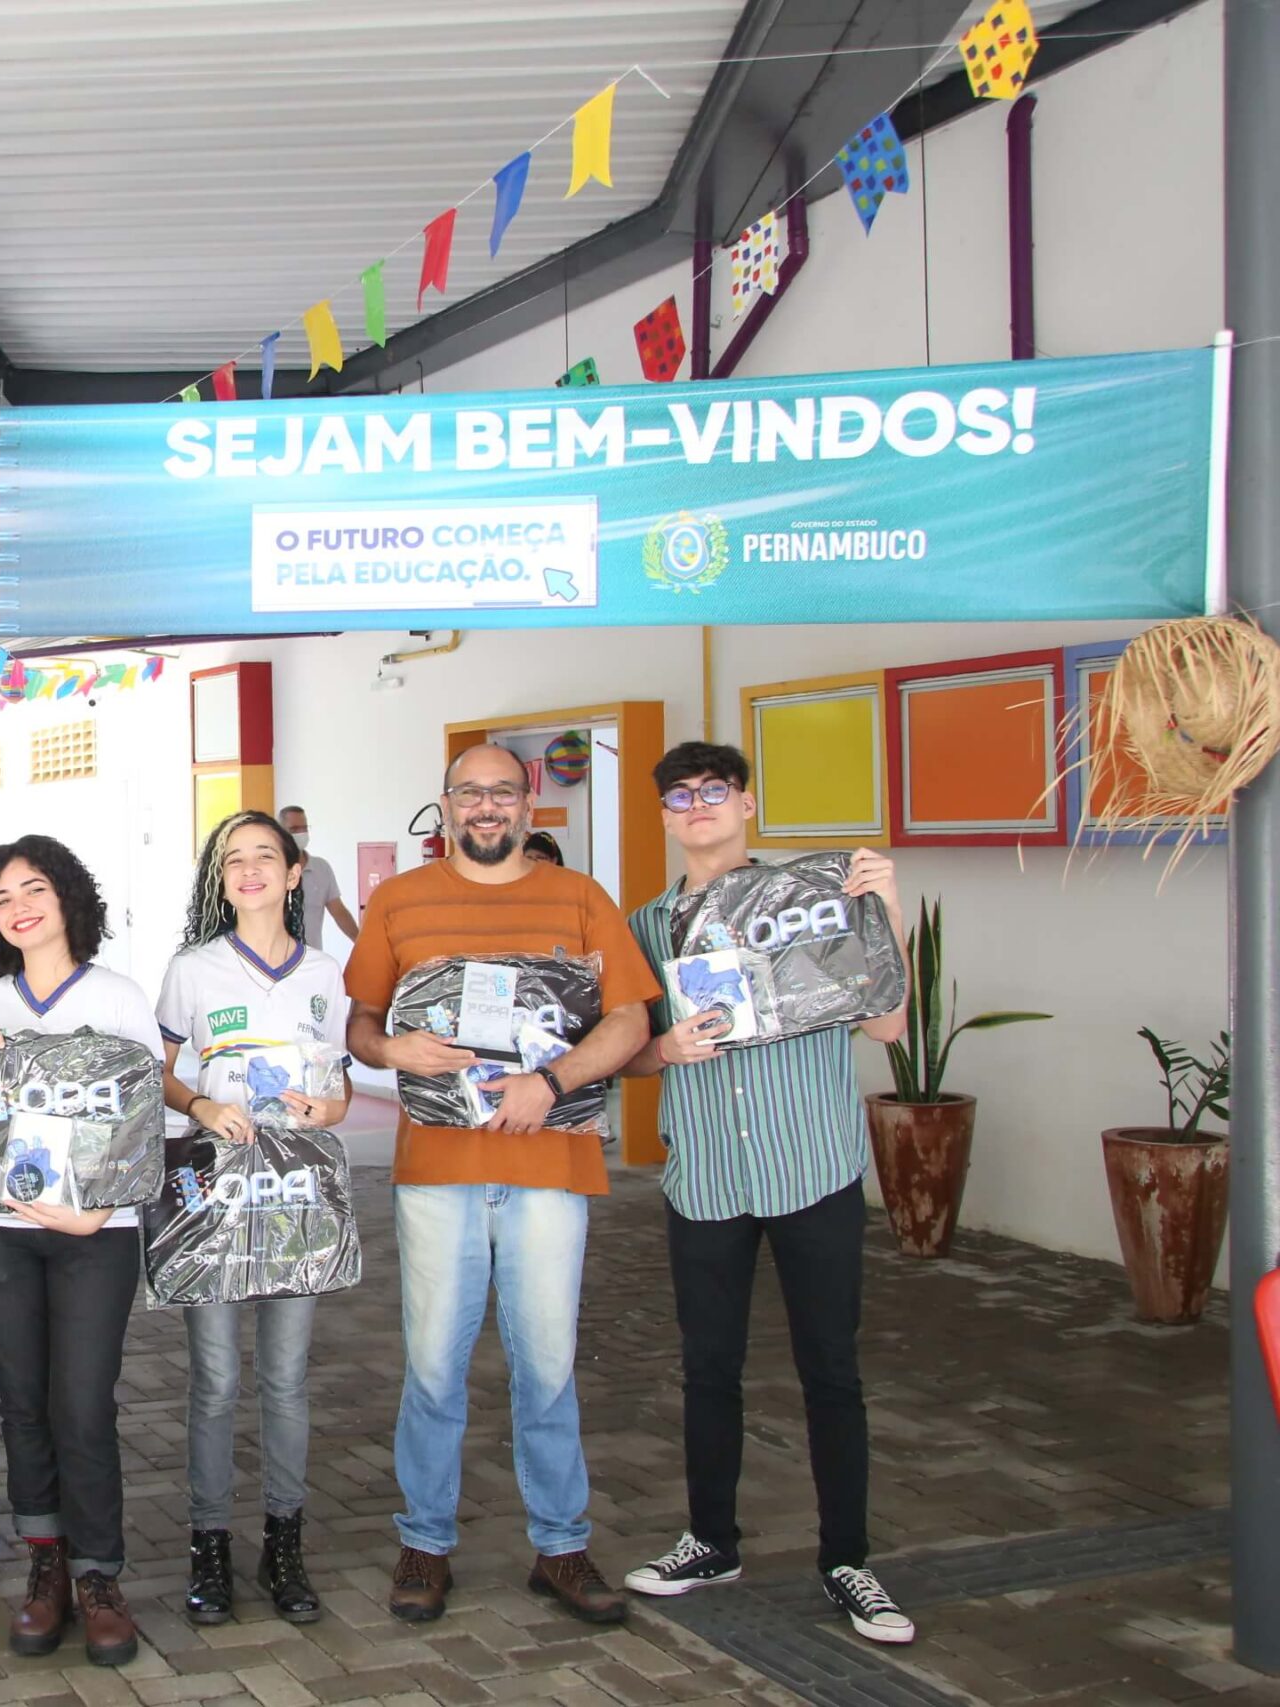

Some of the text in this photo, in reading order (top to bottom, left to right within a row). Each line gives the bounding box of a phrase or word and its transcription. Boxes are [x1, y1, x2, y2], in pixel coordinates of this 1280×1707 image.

[163, 387, 1037, 479] SEJAM BEM-VINDOS!
[276, 522, 567, 553] O FUTURO COMEÇA
[790, 519, 878, 529] GOVERNO DO ESTADO
[742, 530, 927, 563] PERNAMBUCO
[276, 553, 531, 589] PELA EDUCAÇÃO.
[747, 899, 849, 948] OPA
[208, 1008, 246, 1030] NAVE
[20, 1080, 121, 1115] OPA
[215, 1170, 318, 1206] OPA
